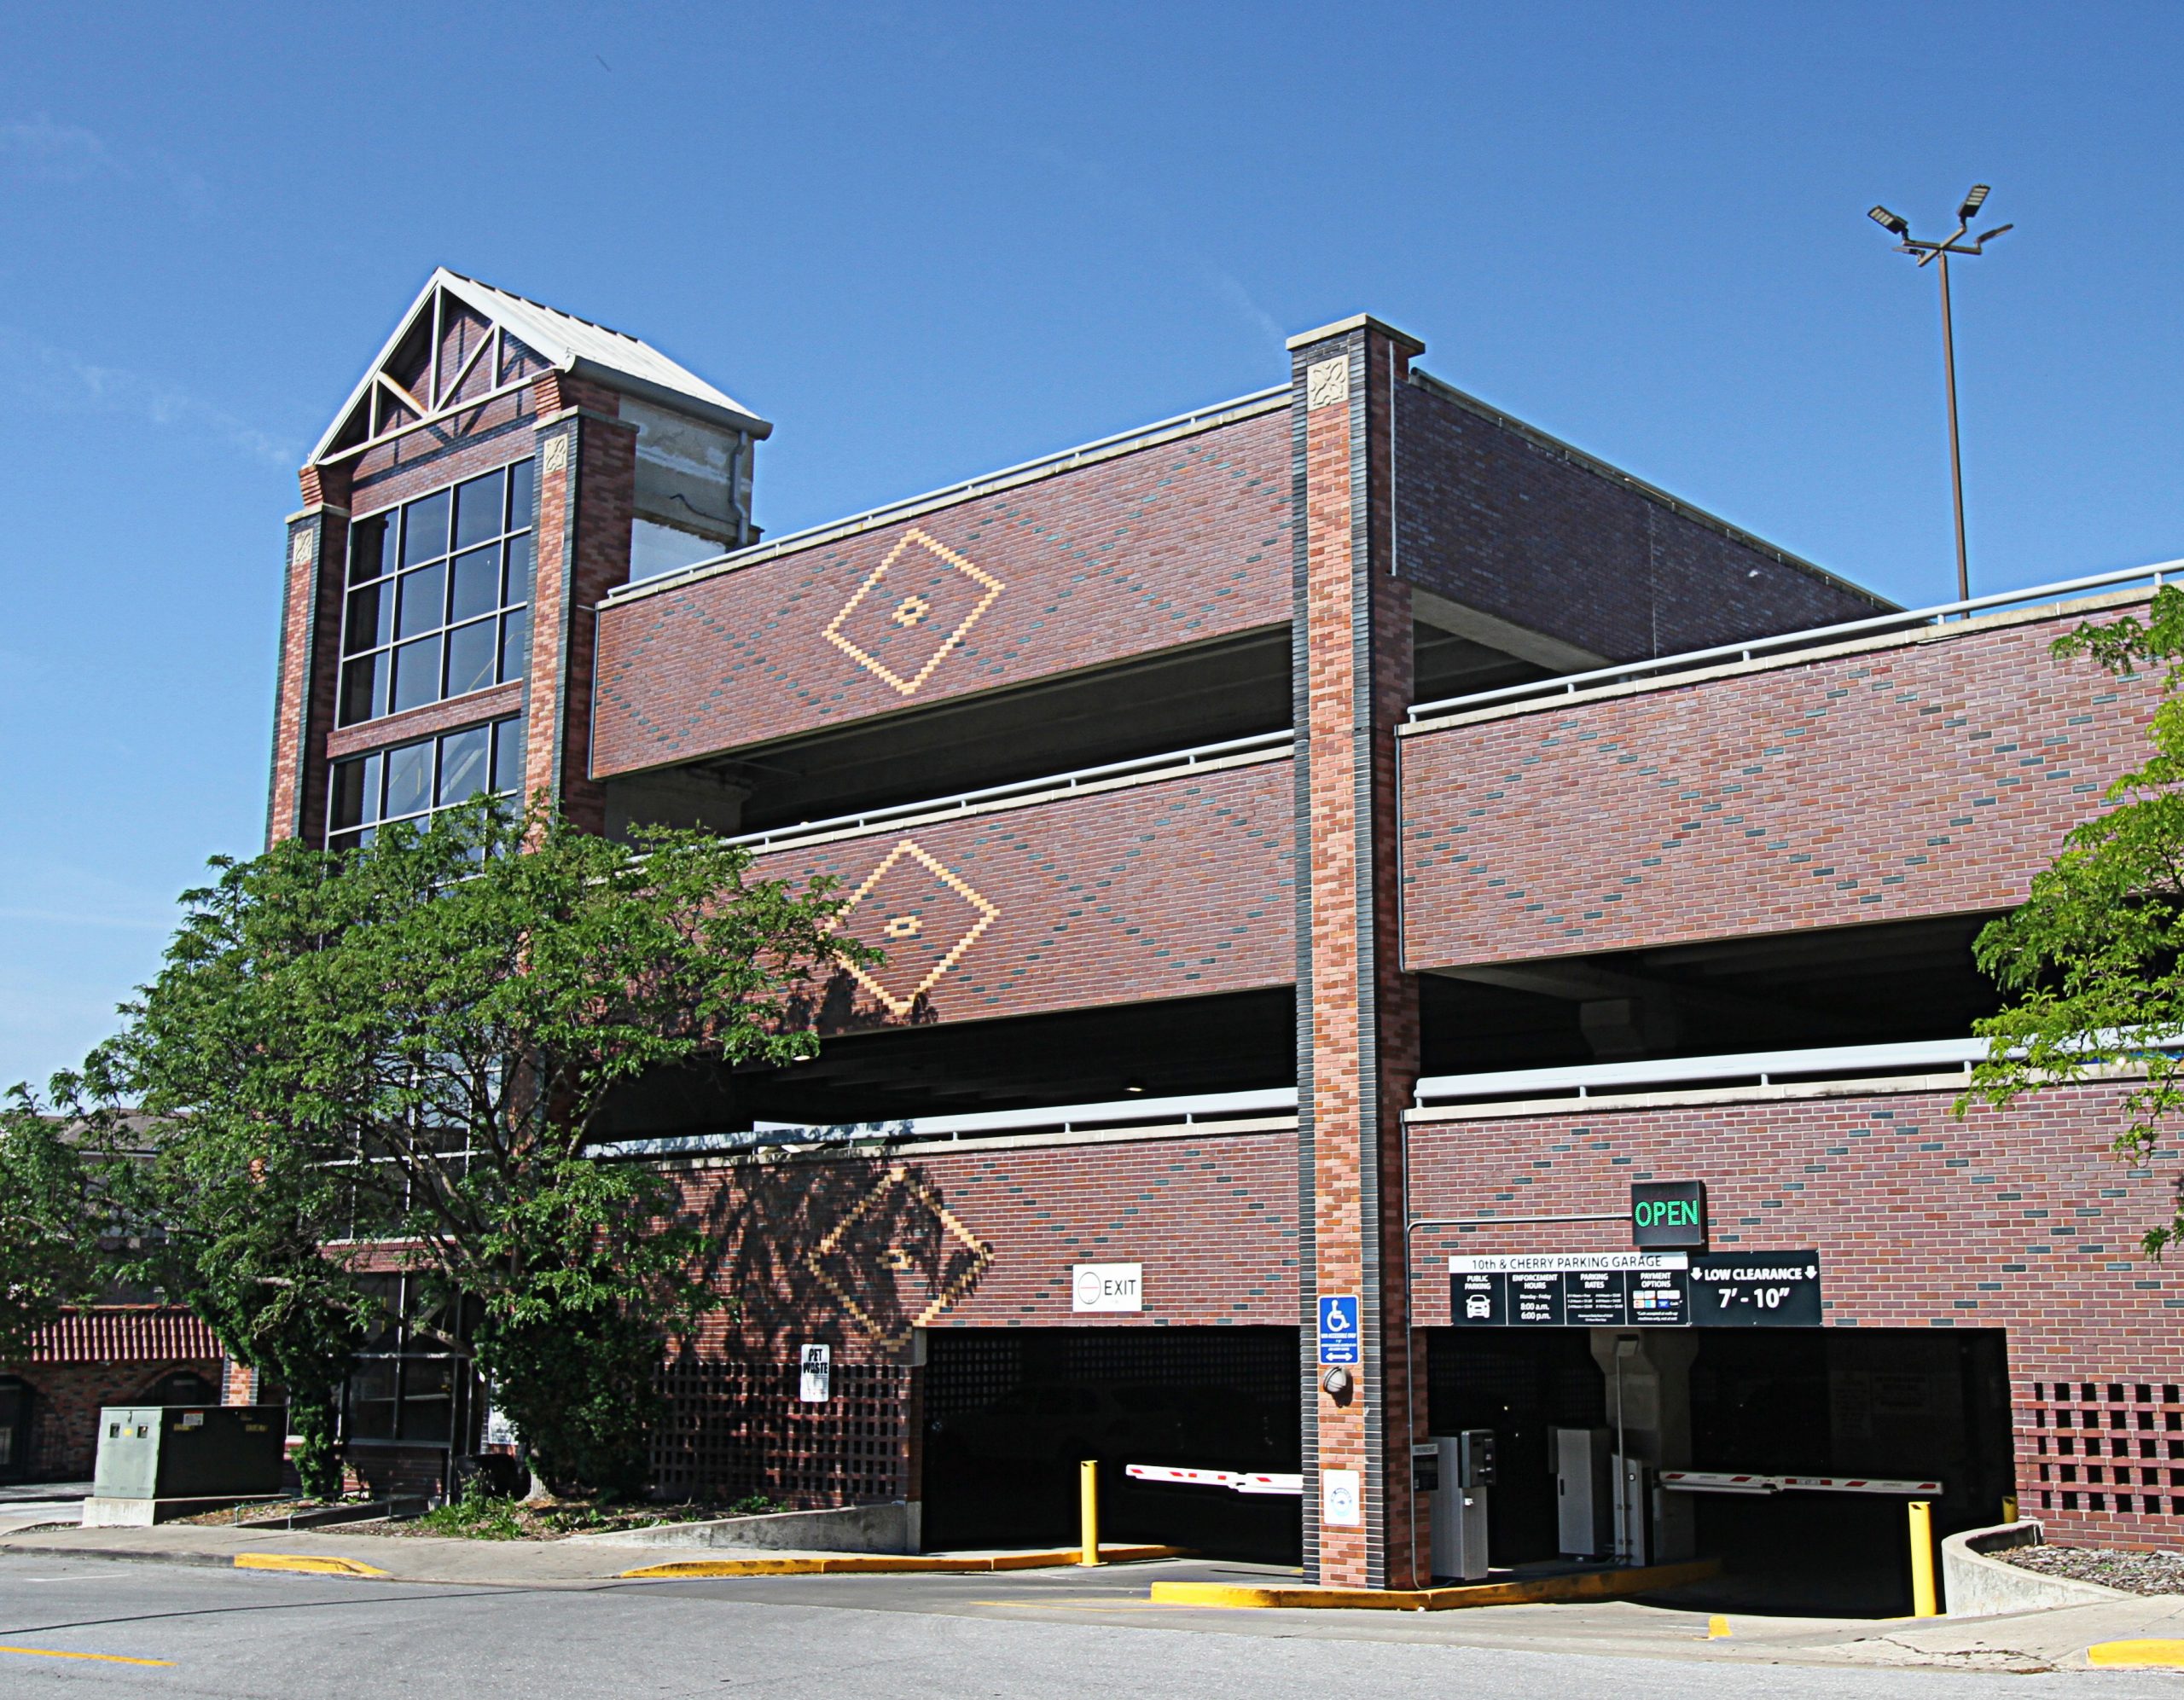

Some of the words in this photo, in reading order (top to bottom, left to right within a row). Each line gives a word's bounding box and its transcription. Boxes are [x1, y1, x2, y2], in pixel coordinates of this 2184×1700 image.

[1635, 1199, 1699, 1227] OPEN
[1472, 1259, 1496, 1270] 10th
[1499, 1259, 1507, 1269] &
[1509, 1258, 1554, 1269] CHERRY
[1557, 1256, 1609, 1268] PARKING
[1612, 1255, 1662, 1268] GARAGE
[1512, 1274, 1558, 1282] ENFORCEMENT
[1580, 1273, 1609, 1281] PARKING
[1640, 1272, 1671, 1280] PAYMENT
[1705, 1268, 1731, 1281] LOW
[1732, 1268, 1803, 1280] CLEARANCE
[1104, 1279, 1136, 1296] EXIT
[1584, 1280, 1605, 1289] RATES
[1641, 1279, 1671, 1288] OPTIONS
[1536, 1313, 1551, 1321] p.m.
[808, 1349, 822, 1361] PET
[803, 1362, 828, 1374] WASTE
